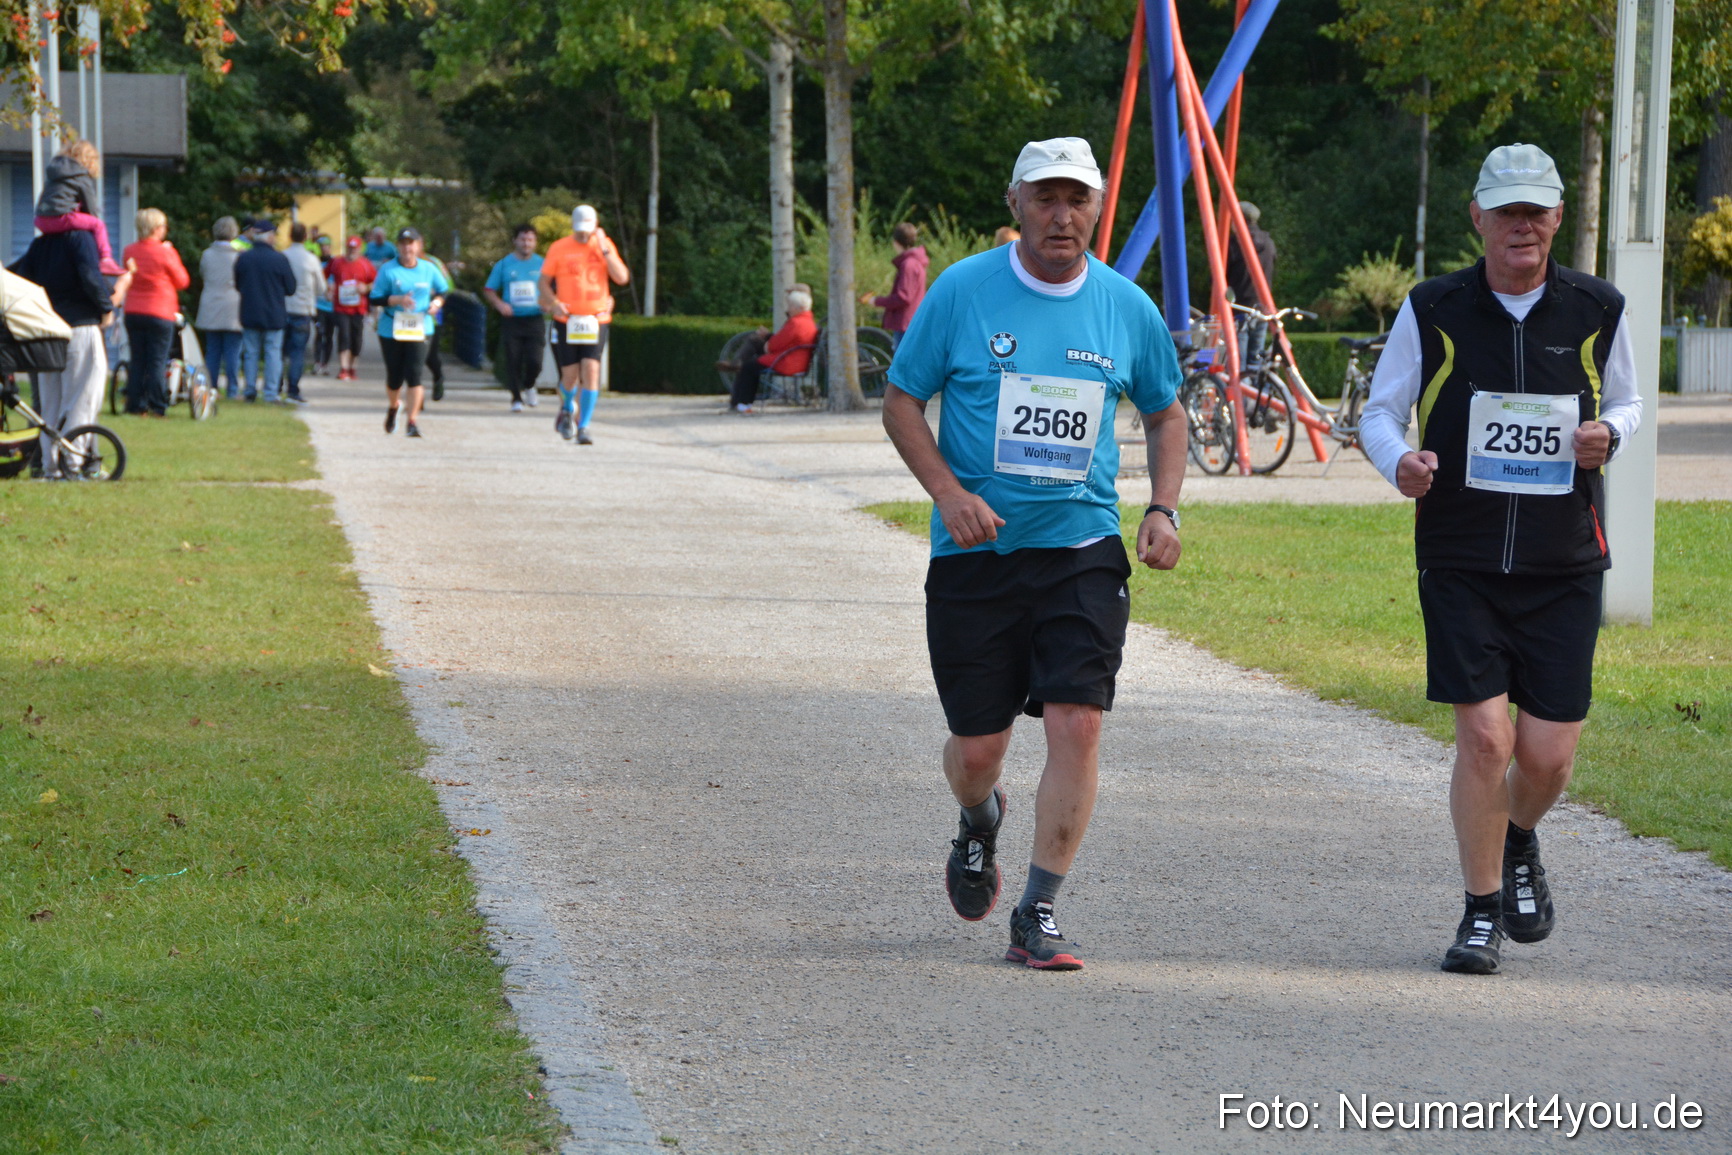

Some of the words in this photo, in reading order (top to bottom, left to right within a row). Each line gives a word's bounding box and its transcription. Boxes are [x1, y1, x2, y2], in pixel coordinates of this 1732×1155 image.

[991, 333, 1015, 343] BMW
[989, 361, 1018, 369] PARTL
[1066, 349, 1115, 370] BOCK
[1041, 385, 1077, 397] BOCK
[1512, 402, 1550, 413] BOCK
[1012, 404, 1087, 441] 2568
[1484, 422, 1561, 456] 2355
[1024, 446, 1071, 463] Wolfgang
[1502, 463, 1540, 477] Hubert
